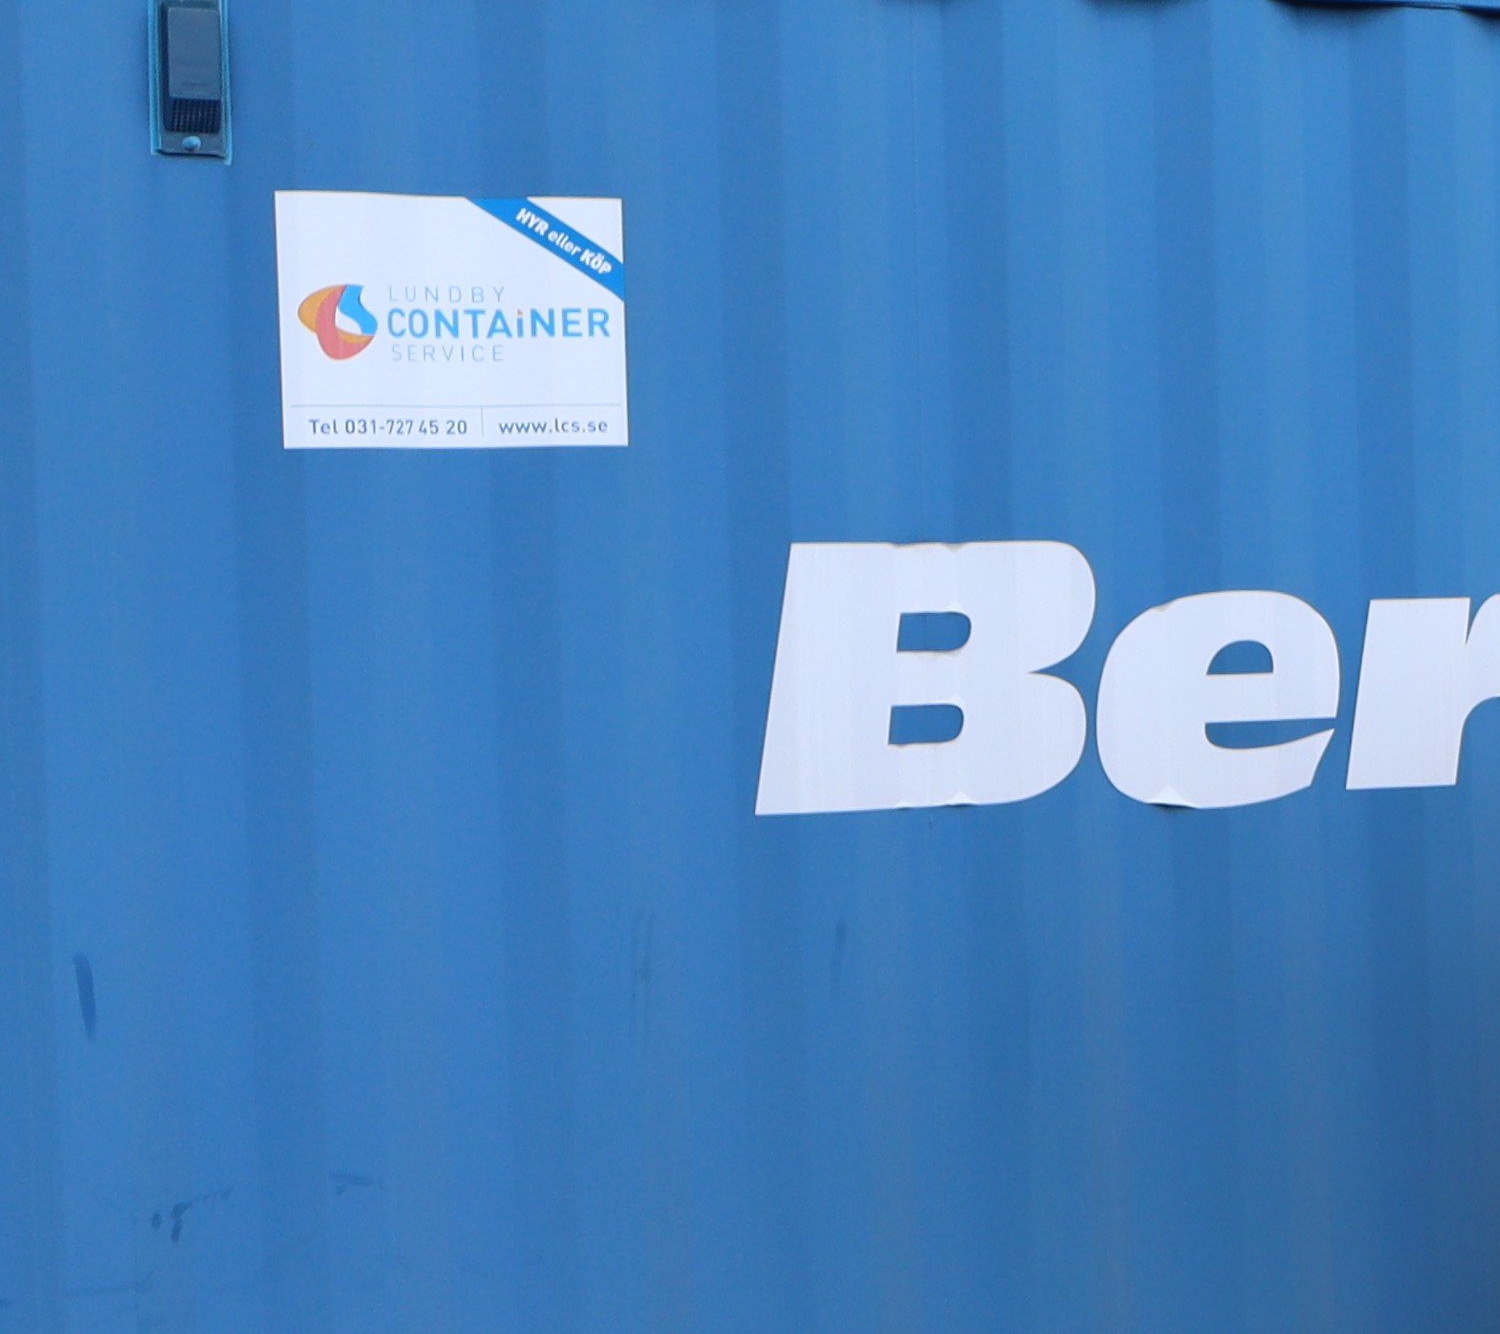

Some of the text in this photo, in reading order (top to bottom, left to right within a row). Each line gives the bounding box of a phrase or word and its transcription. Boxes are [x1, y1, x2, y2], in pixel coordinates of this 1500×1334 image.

[515, 207, 613, 276] HYR eller KÖP
[388, 284, 505, 303] LUNDBY
[391, 344, 504, 363] SERVICE
[308, 419, 468, 435] Tel 031-727 45 20
[498, 418, 608, 435] www.lcs.se
